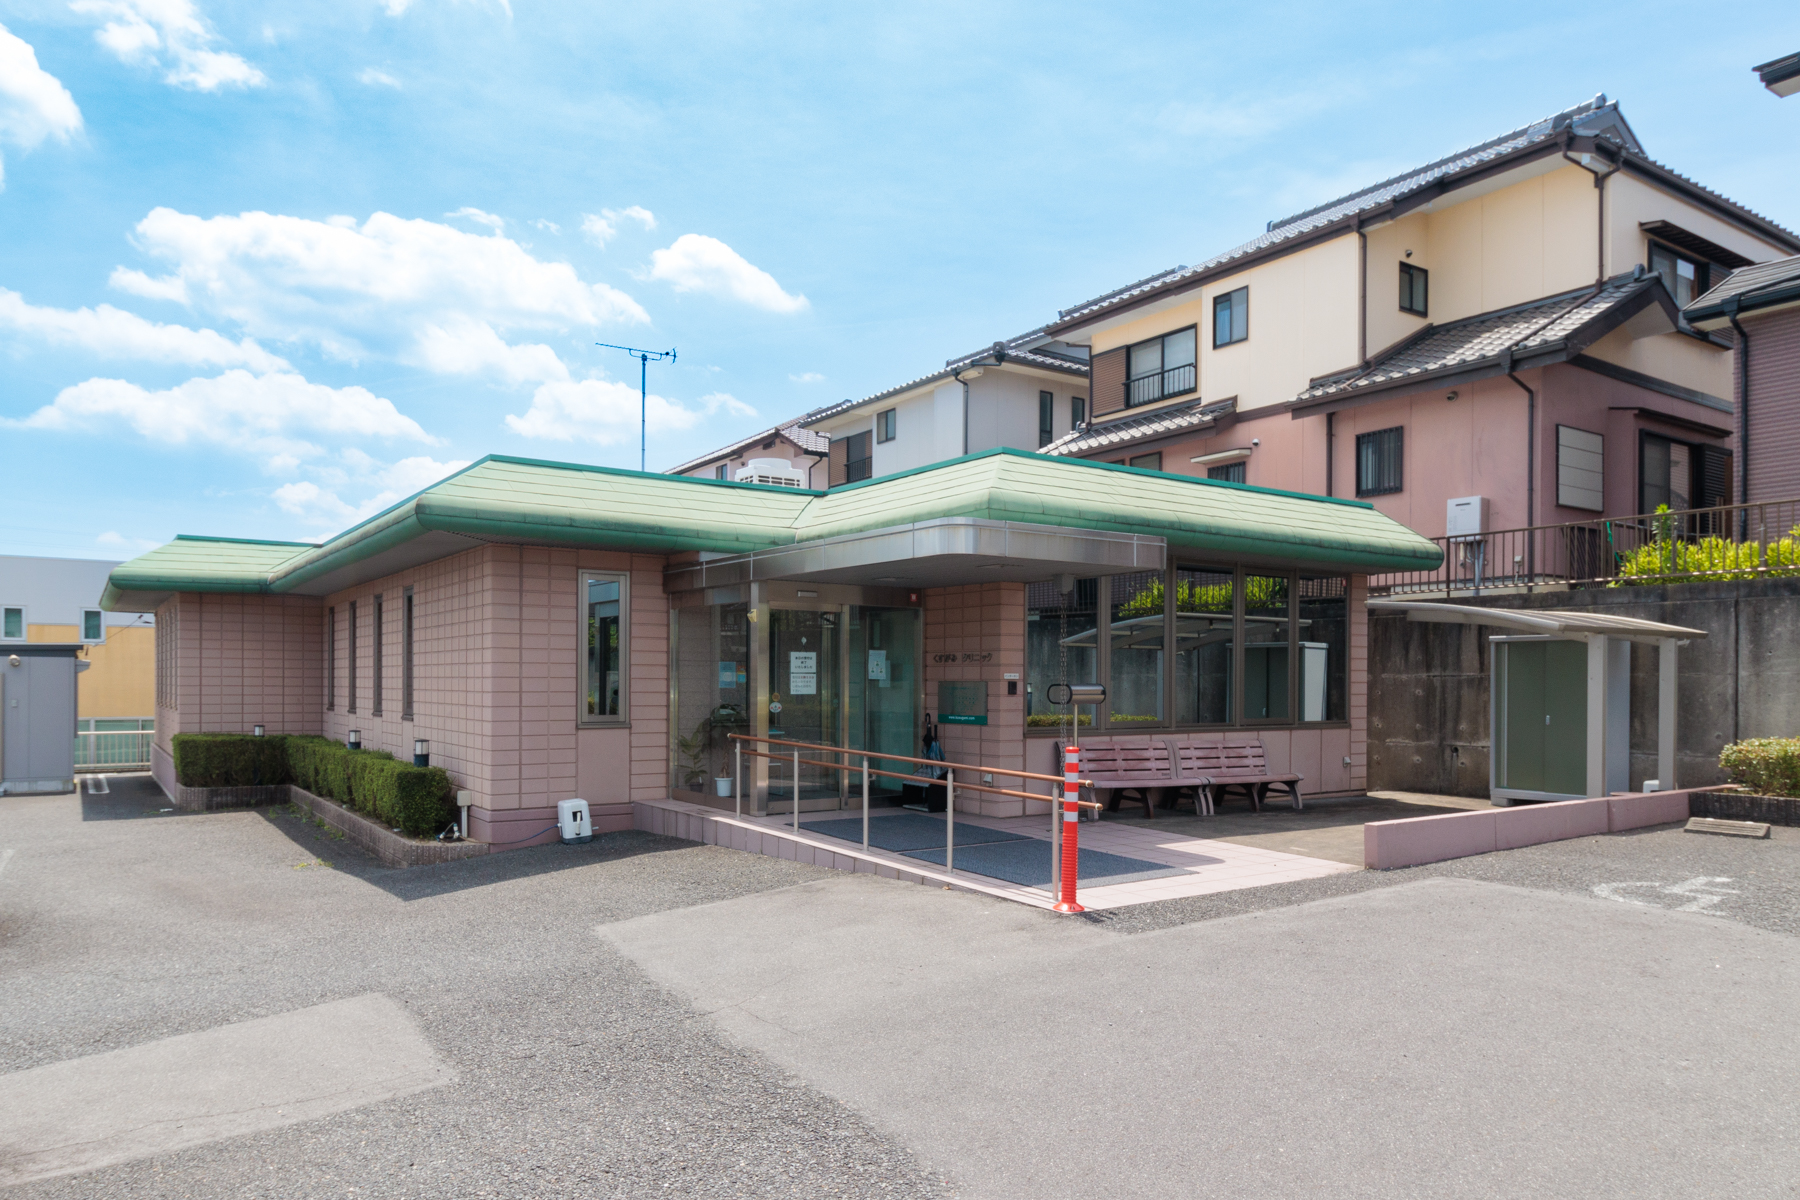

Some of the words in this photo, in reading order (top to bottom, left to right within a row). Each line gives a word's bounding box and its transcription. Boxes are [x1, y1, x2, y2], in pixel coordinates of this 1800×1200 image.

[962, 652, 992, 662] クリニック
